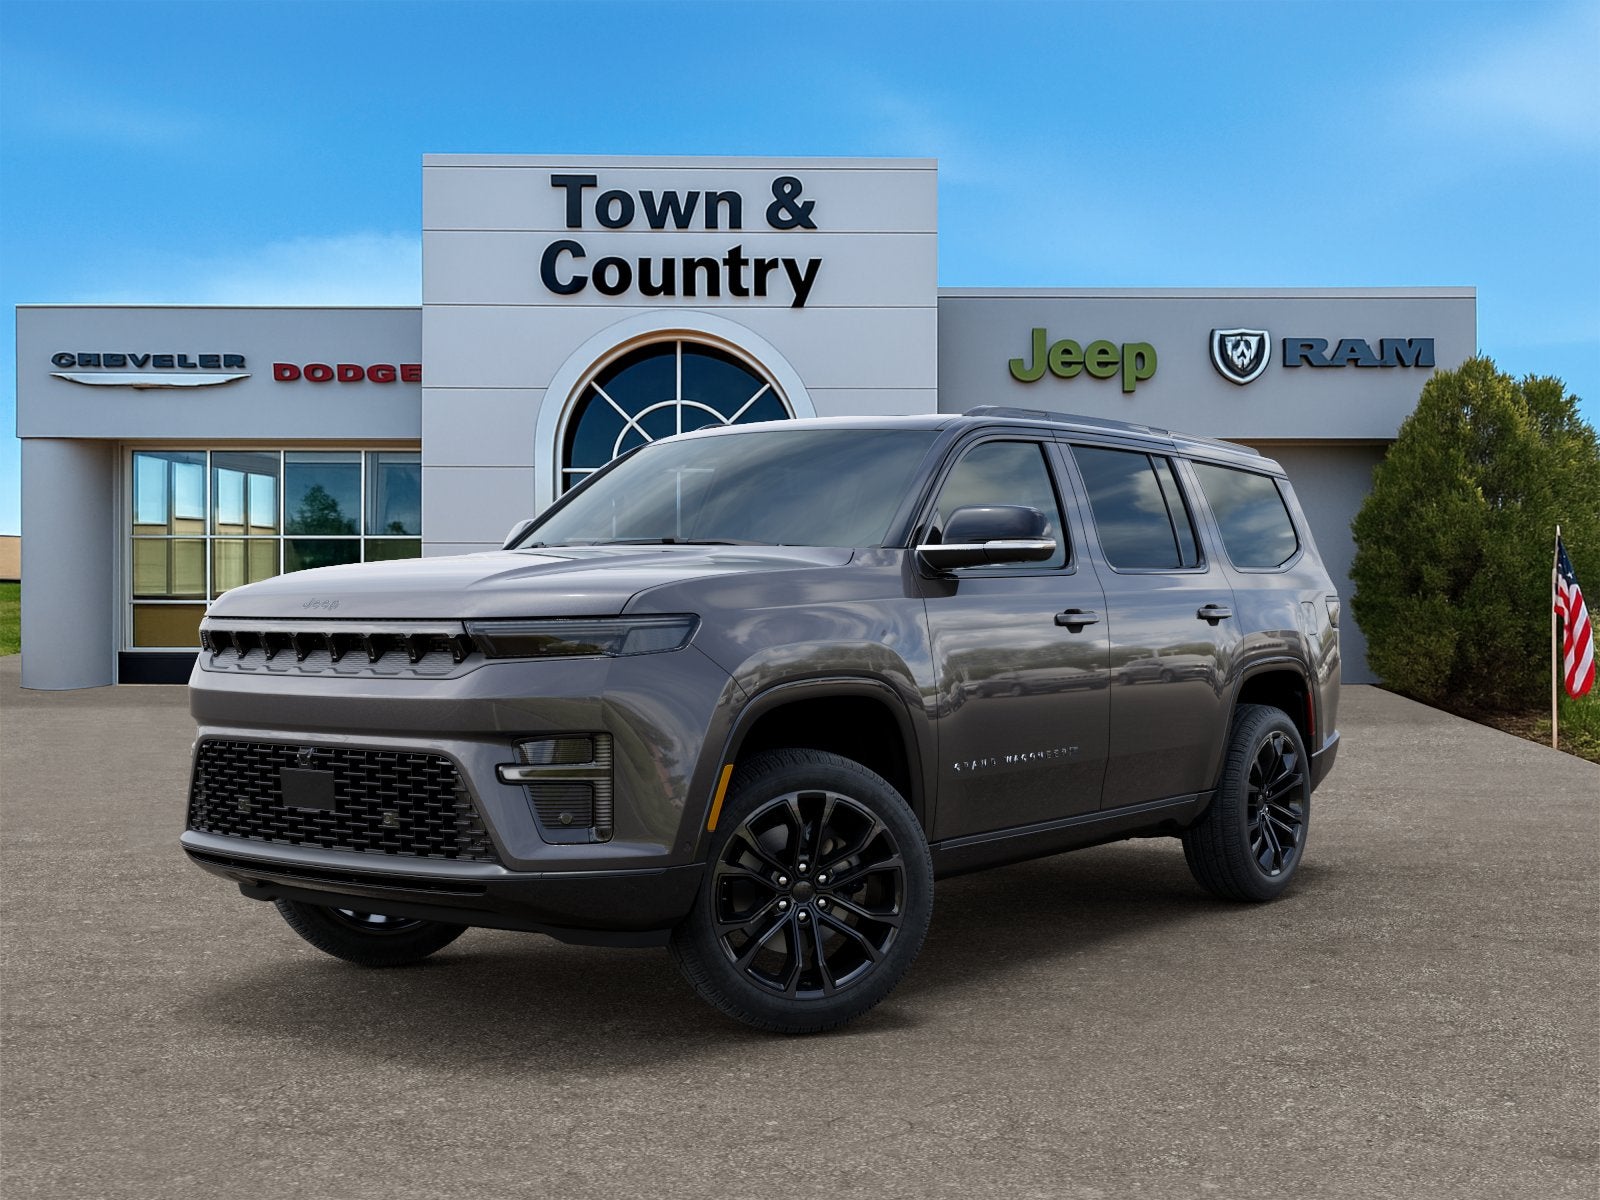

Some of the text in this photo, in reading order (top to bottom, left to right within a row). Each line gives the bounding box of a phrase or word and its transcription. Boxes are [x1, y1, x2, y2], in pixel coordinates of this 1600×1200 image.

[550, 174, 818, 230] Town &
[540, 239, 822, 308] Country
[273, 363, 422, 382] DODGE
[1009, 328, 1157, 393] Jeep
[1282, 337, 1435, 367] RAM
[302, 598, 340, 611] Jeep
